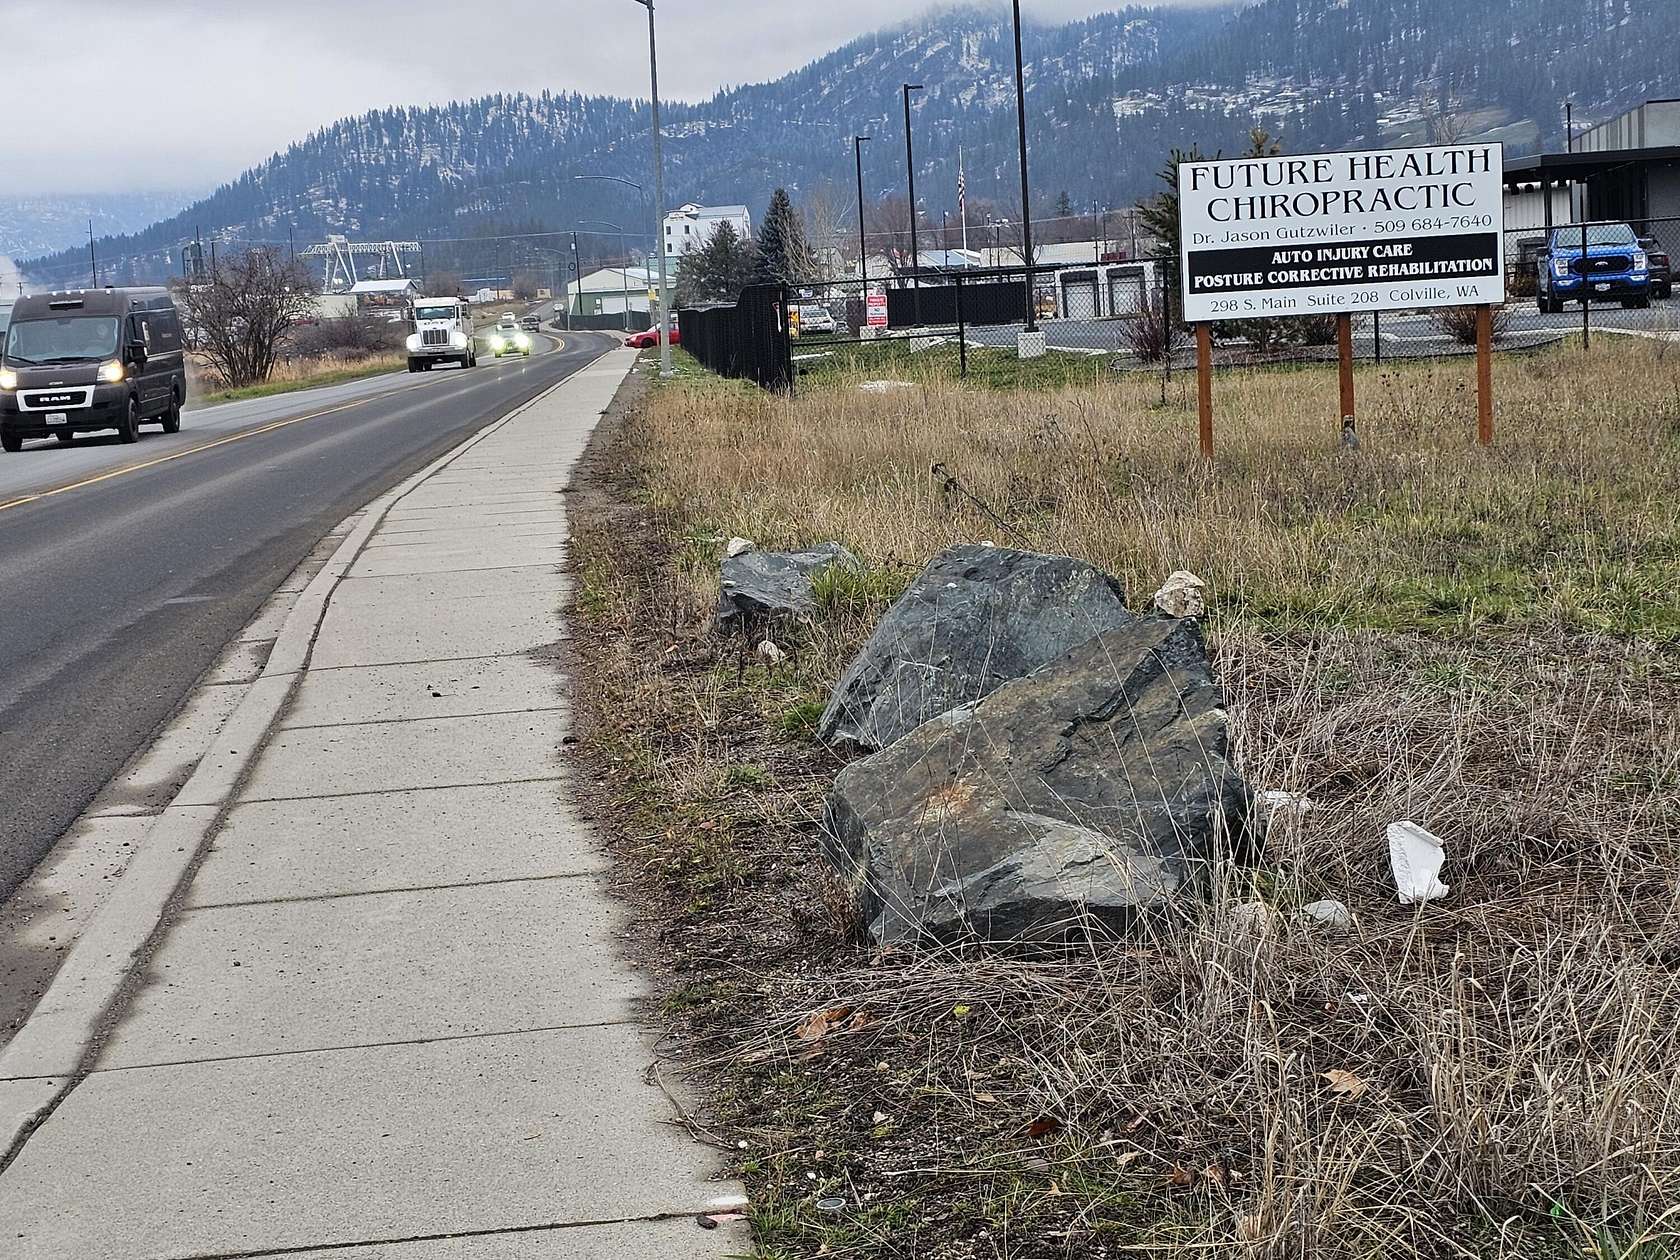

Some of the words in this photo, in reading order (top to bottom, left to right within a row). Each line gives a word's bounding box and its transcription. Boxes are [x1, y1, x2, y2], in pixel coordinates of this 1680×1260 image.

[1190, 158, 1333, 191] FUTURE
[1349, 148, 1490, 181] HEALTH
[1207, 182, 1476, 222] CHIROPRACTIC
[1193, 233, 1215, 244] Dr.
[1220, 230, 1270, 243] Jason
[1276, 223, 1356, 239] Gutzwiler
[1374, 219, 1406, 234] 509
[1411, 214, 1492, 231] 684-7640
[1271, 250, 1313, 264] AUTO
[1317, 246, 1370, 262] INJURY
[1373, 243, 1413, 258] CARE
[1194, 272, 1263, 288] POSTURE
[1267, 266, 1363, 284] CORRECTIVE
[1367, 258, 1493, 278] REHABILITATION
[1210, 300, 1239, 313] 298
[1243, 298, 1257, 310] S.
[1261, 296, 1297, 310] Main
[1307, 292, 1345, 307] Suite
[1351, 291, 1379, 303] 208
[1389, 287, 1450, 302] Colville,
[1457, 285, 1479, 297] WA
